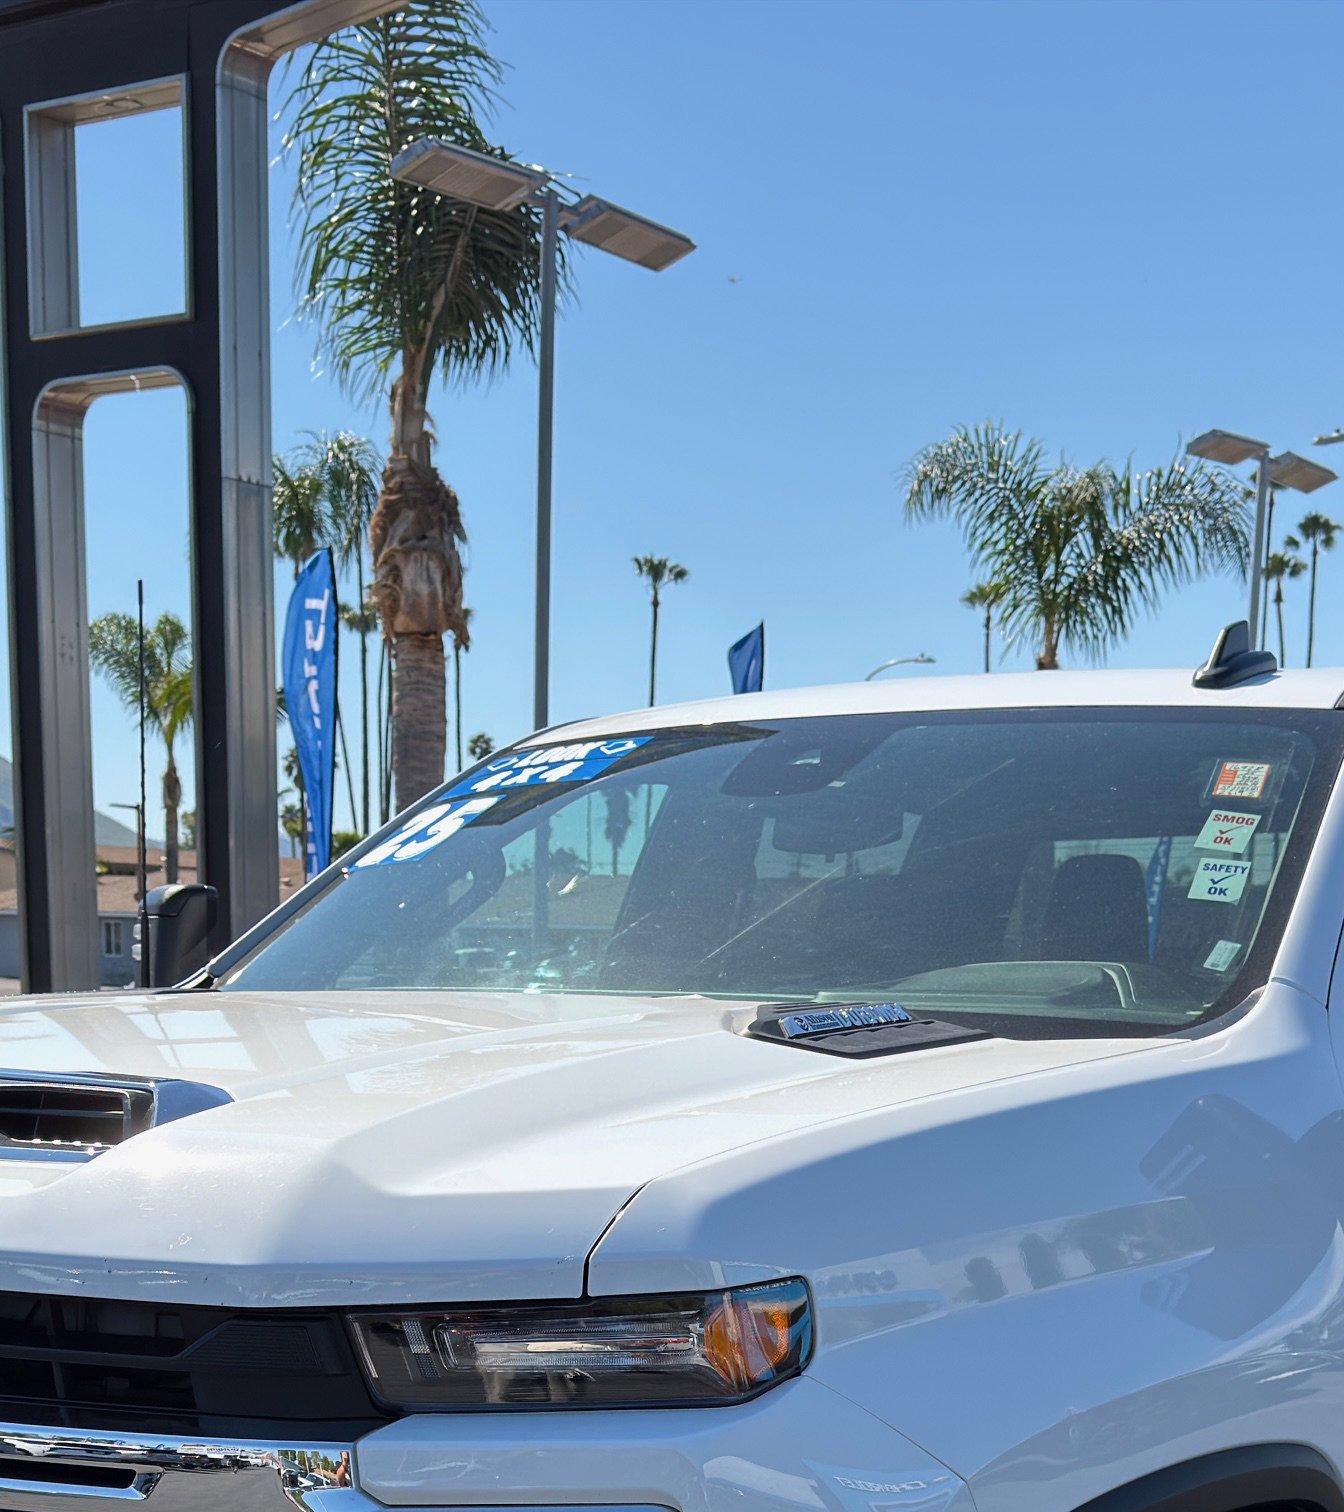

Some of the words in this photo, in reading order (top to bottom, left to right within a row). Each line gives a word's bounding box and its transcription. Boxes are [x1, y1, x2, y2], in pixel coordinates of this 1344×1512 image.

[1212, 814, 1255, 826] SMOG
[1213, 836, 1234, 846] OK
[1202, 862, 1248, 875] SAFETY
[1207, 886, 1229, 896] OK
